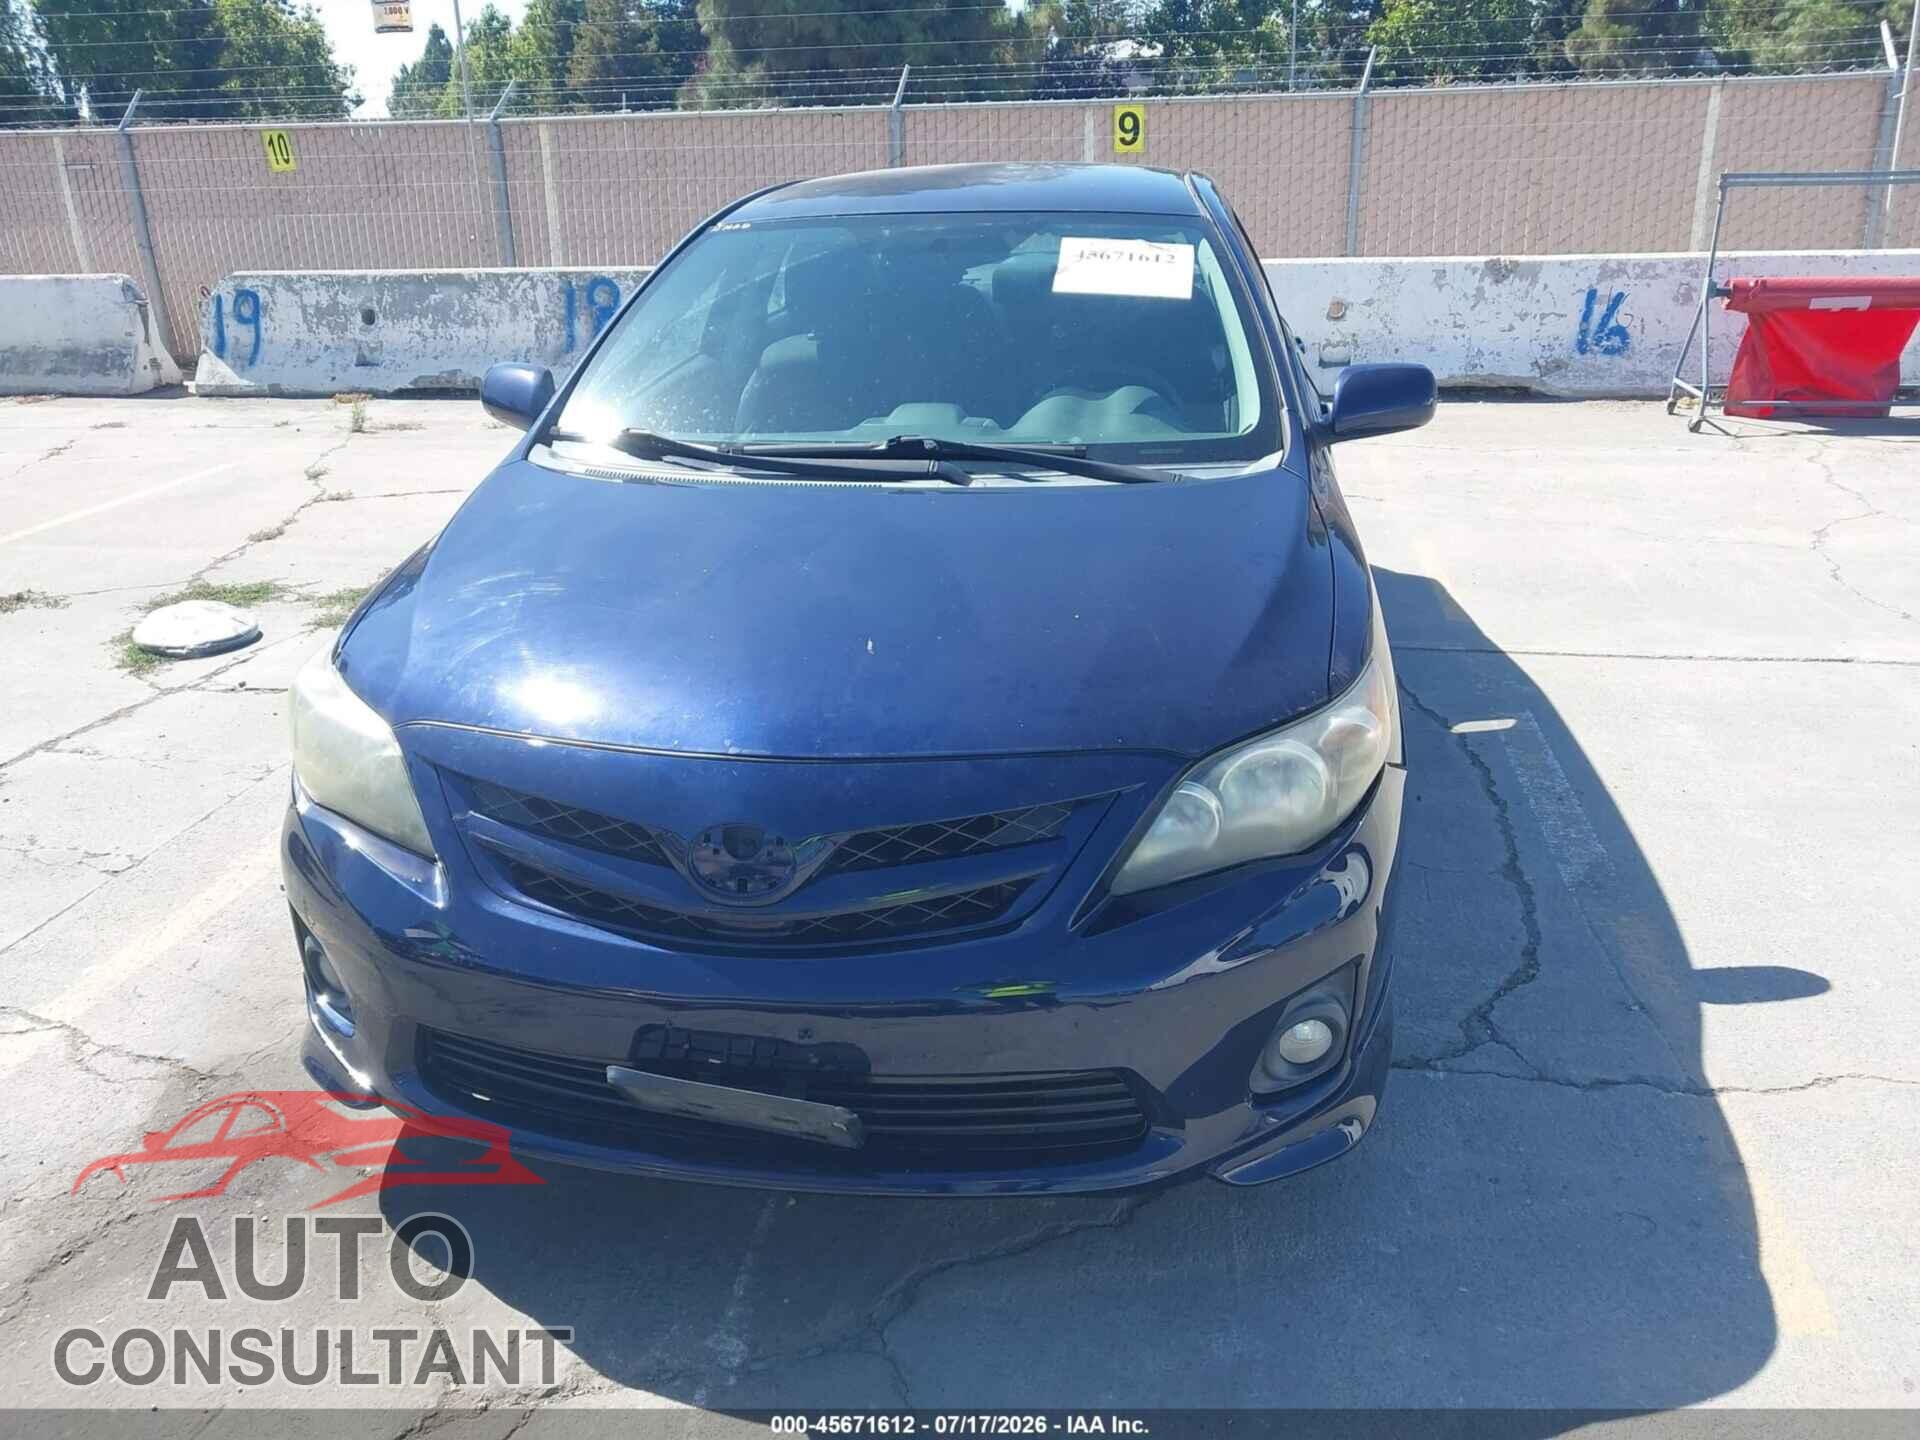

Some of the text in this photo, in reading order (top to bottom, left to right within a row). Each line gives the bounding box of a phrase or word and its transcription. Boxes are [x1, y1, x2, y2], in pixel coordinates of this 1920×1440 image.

[268, 133, 290, 165] 10
[1118, 111, 1140, 146] 9
[213, 287, 262, 367] 19
[1576, 287, 1631, 356] 16
